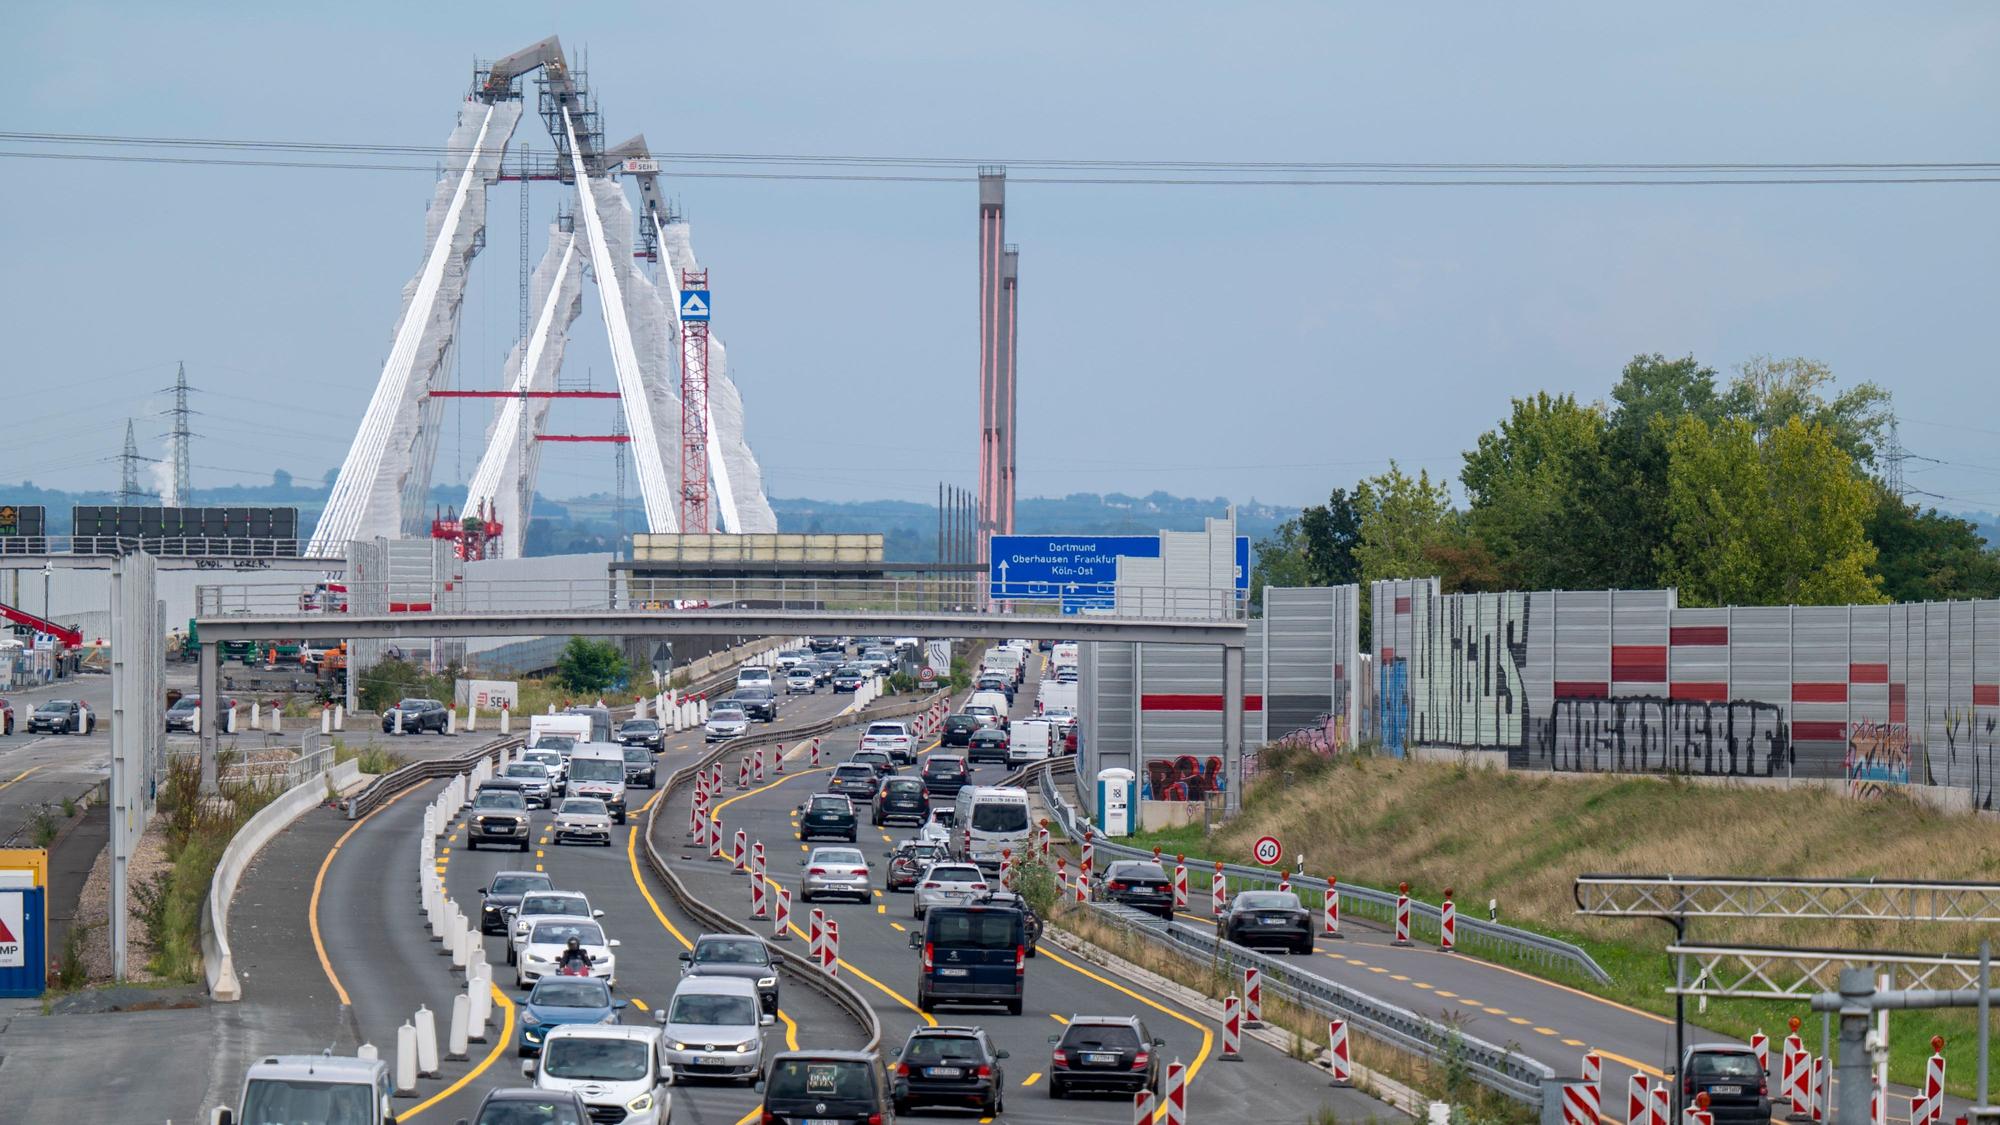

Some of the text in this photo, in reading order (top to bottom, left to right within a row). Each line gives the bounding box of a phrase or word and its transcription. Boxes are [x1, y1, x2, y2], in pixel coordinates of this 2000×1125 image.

[1049, 543, 1096, 551] Dortmund
[1012, 555, 1117, 563] Oberhausen Frankfur
[1052, 566, 1093, 575] Köln-Ost
[490, 696, 511, 709] SEH
[1260, 844, 1276, 858] 60
